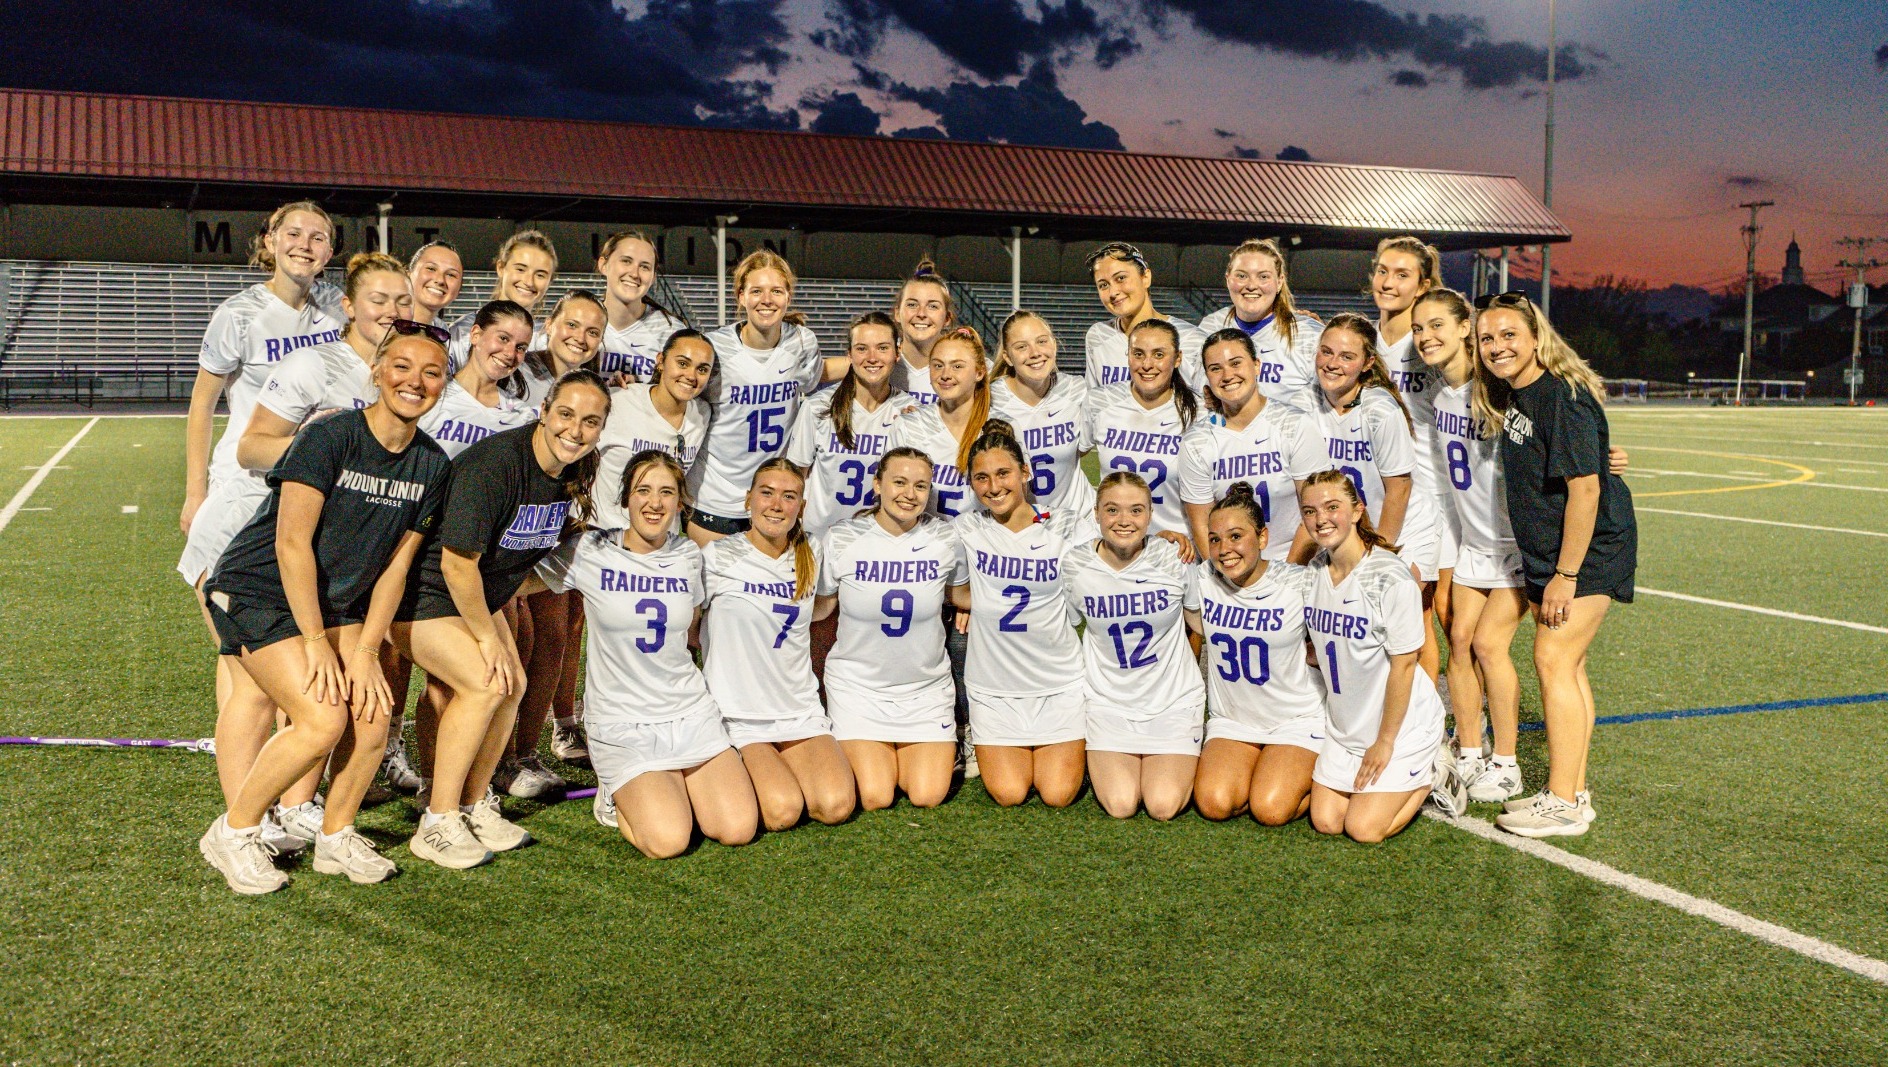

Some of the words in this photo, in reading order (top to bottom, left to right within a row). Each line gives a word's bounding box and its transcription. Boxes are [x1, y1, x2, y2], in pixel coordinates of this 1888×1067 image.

[729, 380, 800, 405] RAIDERS
[745, 406, 786, 453] 15
[1103, 427, 1182, 456] RAIDERS
[336, 468, 388, 496] MOUNT
[835, 459, 879, 507] 32
[1029, 453, 1056, 497] 6
[1446, 439, 1473, 491] 8
[600, 568, 689, 593] RAIDERS
[855, 559, 940, 583] RAIDERS
[976, 549, 1059, 582] RAIDERS
[635, 598, 668, 653] 3
[772, 603, 800, 649] 7
[880, 588, 914, 638] 9
[999, 584, 1031, 633] 2
[1084, 589, 1169, 619] RAIDERS
[1203, 597, 1285, 632] RAIDERS
[1304, 606, 1369, 640] RAIDERS
[1107, 620, 1159, 669] 12
[1210, 632, 1271, 686] 30
[1325, 640, 1342, 694] 1
